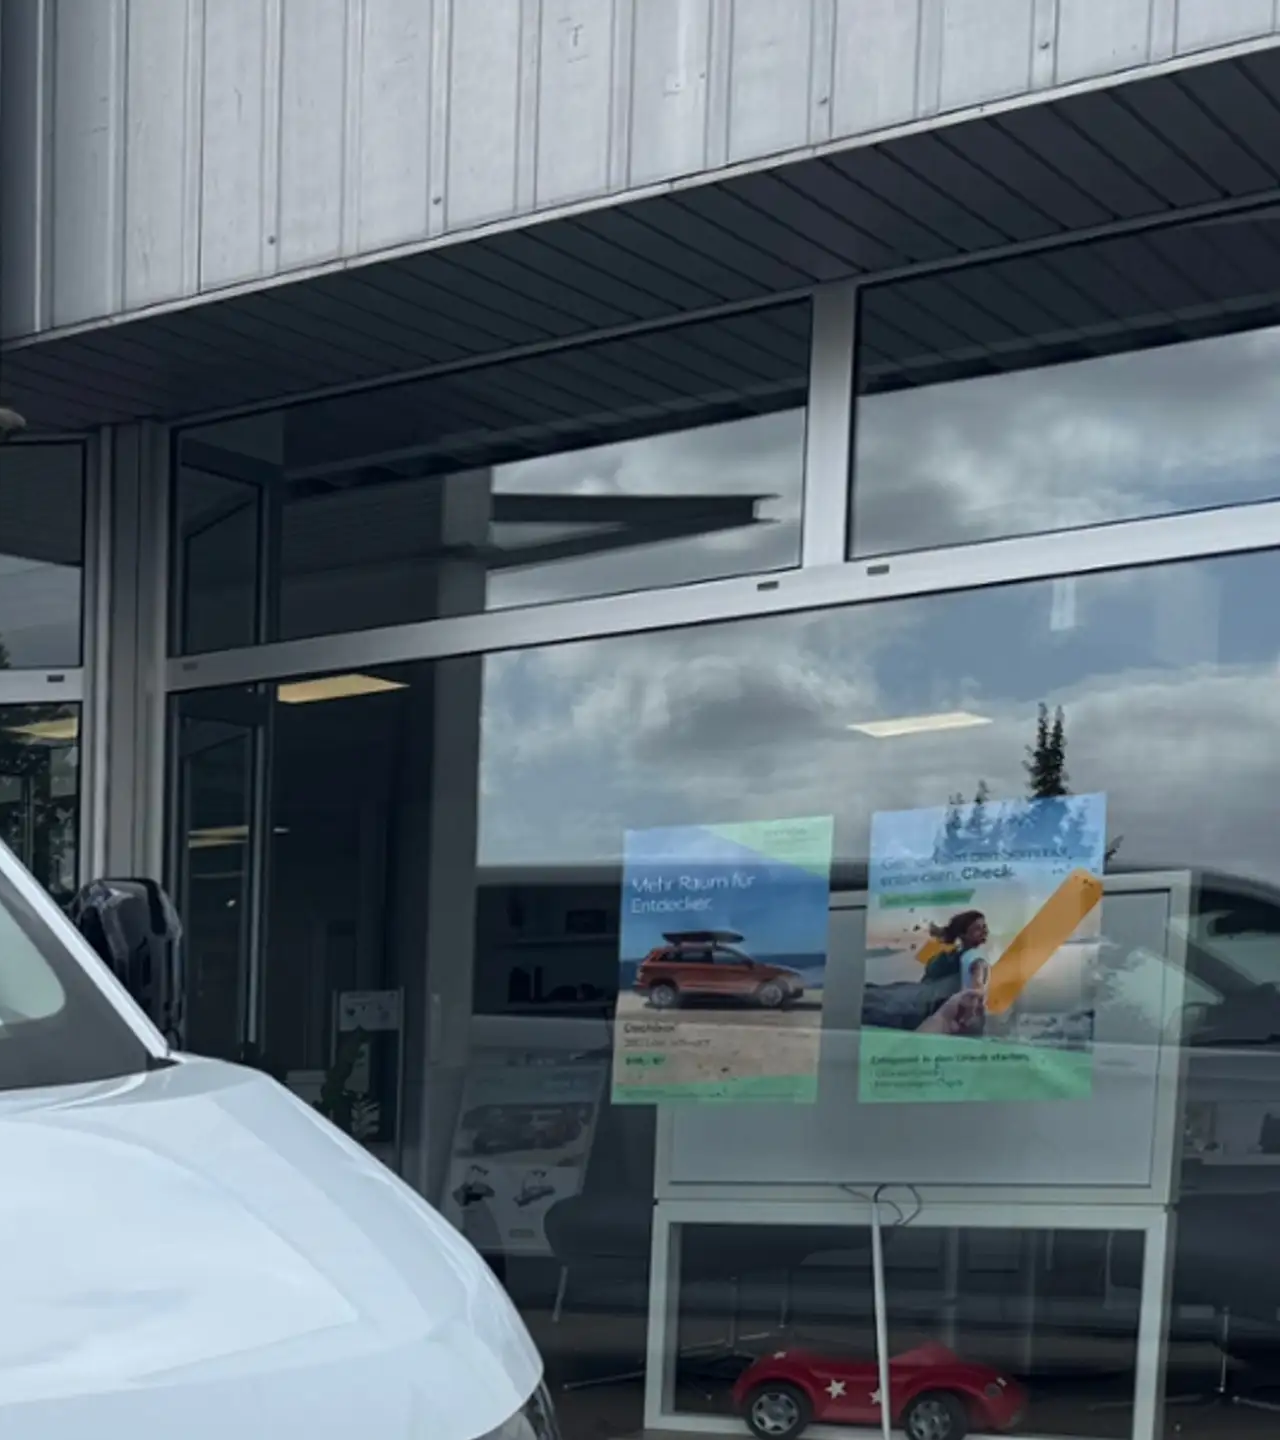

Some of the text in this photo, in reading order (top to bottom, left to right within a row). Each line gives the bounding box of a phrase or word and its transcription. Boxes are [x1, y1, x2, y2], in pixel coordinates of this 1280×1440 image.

[631, 869, 756, 893] Mehr Raum für
